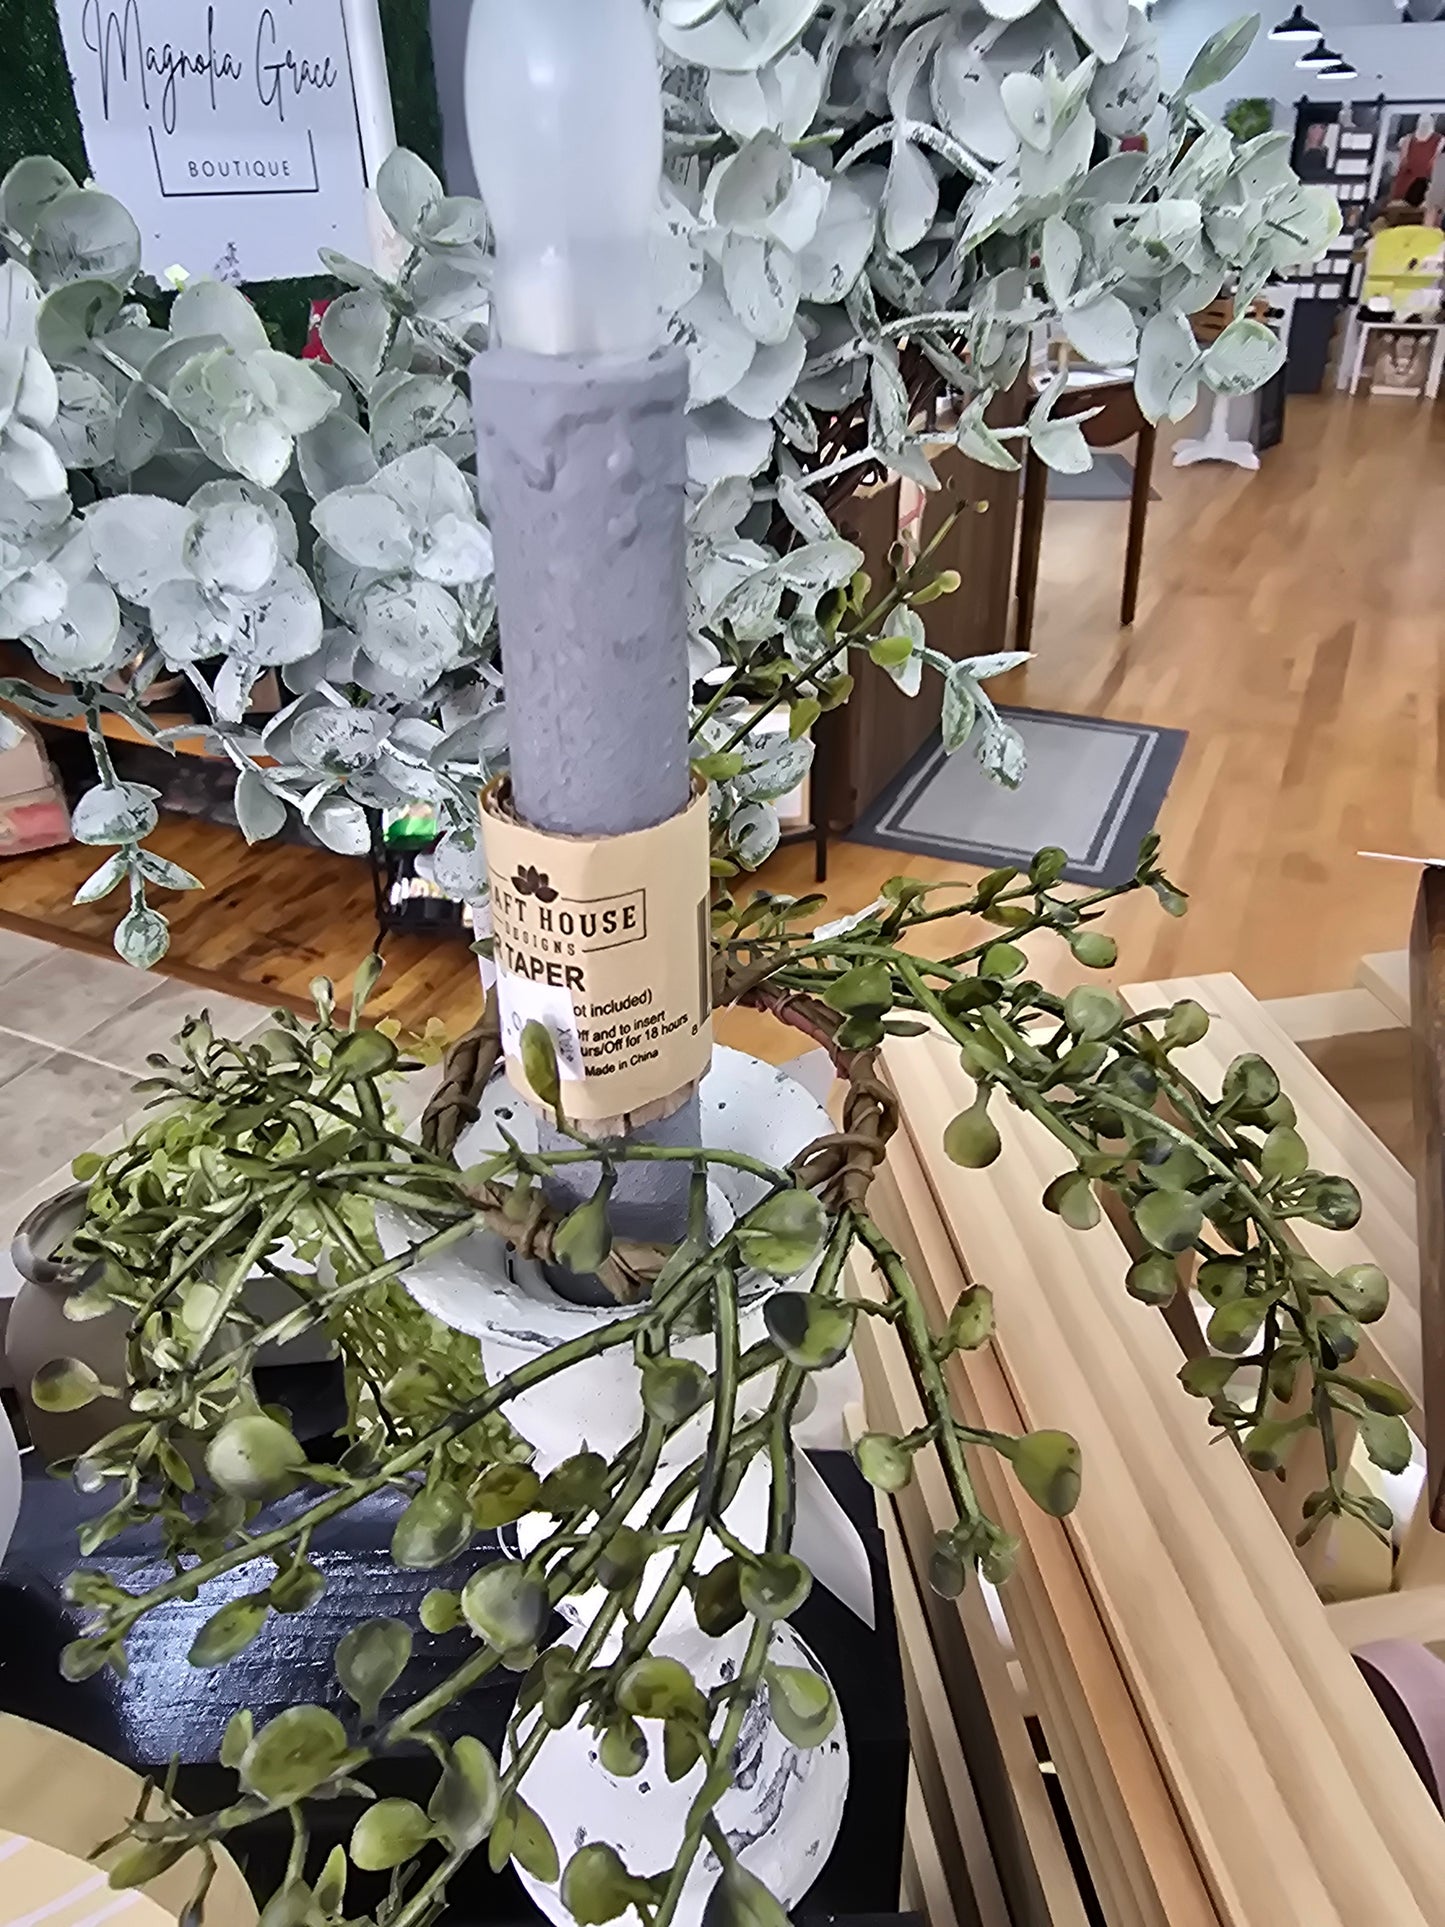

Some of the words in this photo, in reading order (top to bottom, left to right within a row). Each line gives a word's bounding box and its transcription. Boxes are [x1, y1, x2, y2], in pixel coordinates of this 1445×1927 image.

[83, 0, 242, 134] Magnolia
[256, 9, 337, 122] Grace
[187, 160, 291, 178] BOUTIQUE
[494, 885, 527, 922] AFT
[539, 904, 637, 938] HOUSE
[505, 942, 586, 992] TAPER
[573, 1004, 587, 1018] ot
[590, 988, 653, 1018] included)
[580, 1036, 624, 1057] urs/Off
[625, 1033, 642, 1049] for
[645, 1026, 659, 1041] 18
[661, 1013, 689, 1035] hours
[593, 1024, 617, 1042] and
[619, 1023, 631, 1036] to
[633, 1010, 666, 1030] insert
[584, 1063, 616, 1077] Made
[618, 1059, 628, 1070] in
[630, 1049, 660, 1067] China
